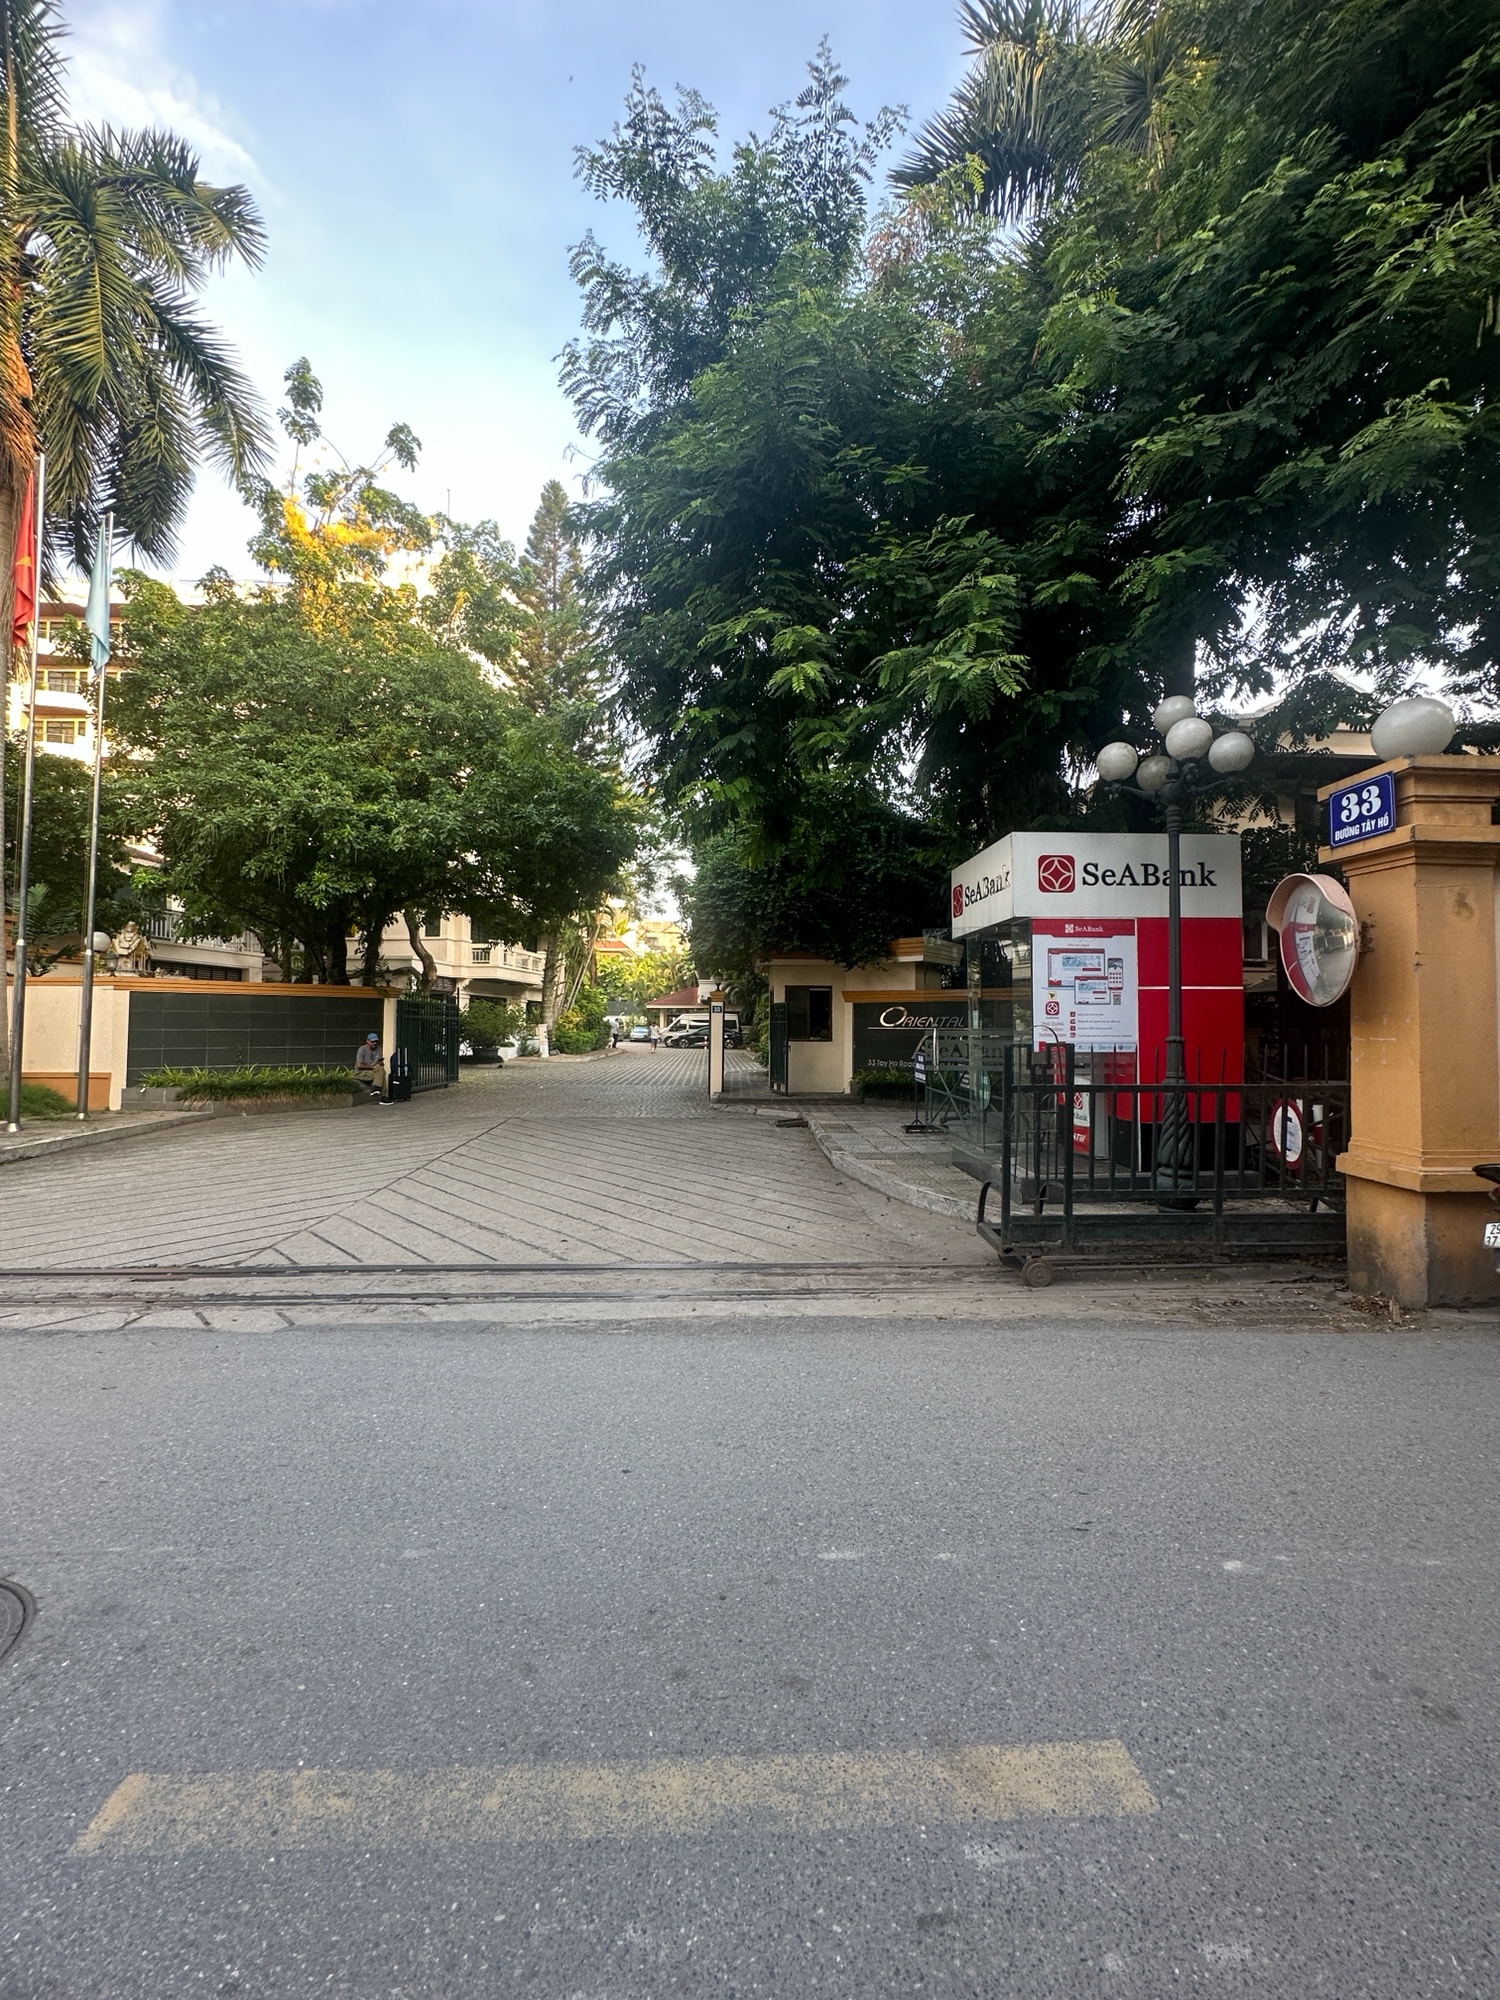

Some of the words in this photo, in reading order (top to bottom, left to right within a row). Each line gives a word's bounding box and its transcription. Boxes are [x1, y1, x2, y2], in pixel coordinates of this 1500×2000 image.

[1341, 785, 1381, 822] 33
[1335, 825, 1359, 841] ĐƯỜNG
[1361, 819, 1376, 832] TÂY
[964, 864, 1011, 908] SeABank
[1082, 862, 1217, 887] SeABank
[1074, 924, 1104, 933] SeABank
[875, 1059, 888, 1068] Tay
[889, 1059, 899, 1067] Ho
